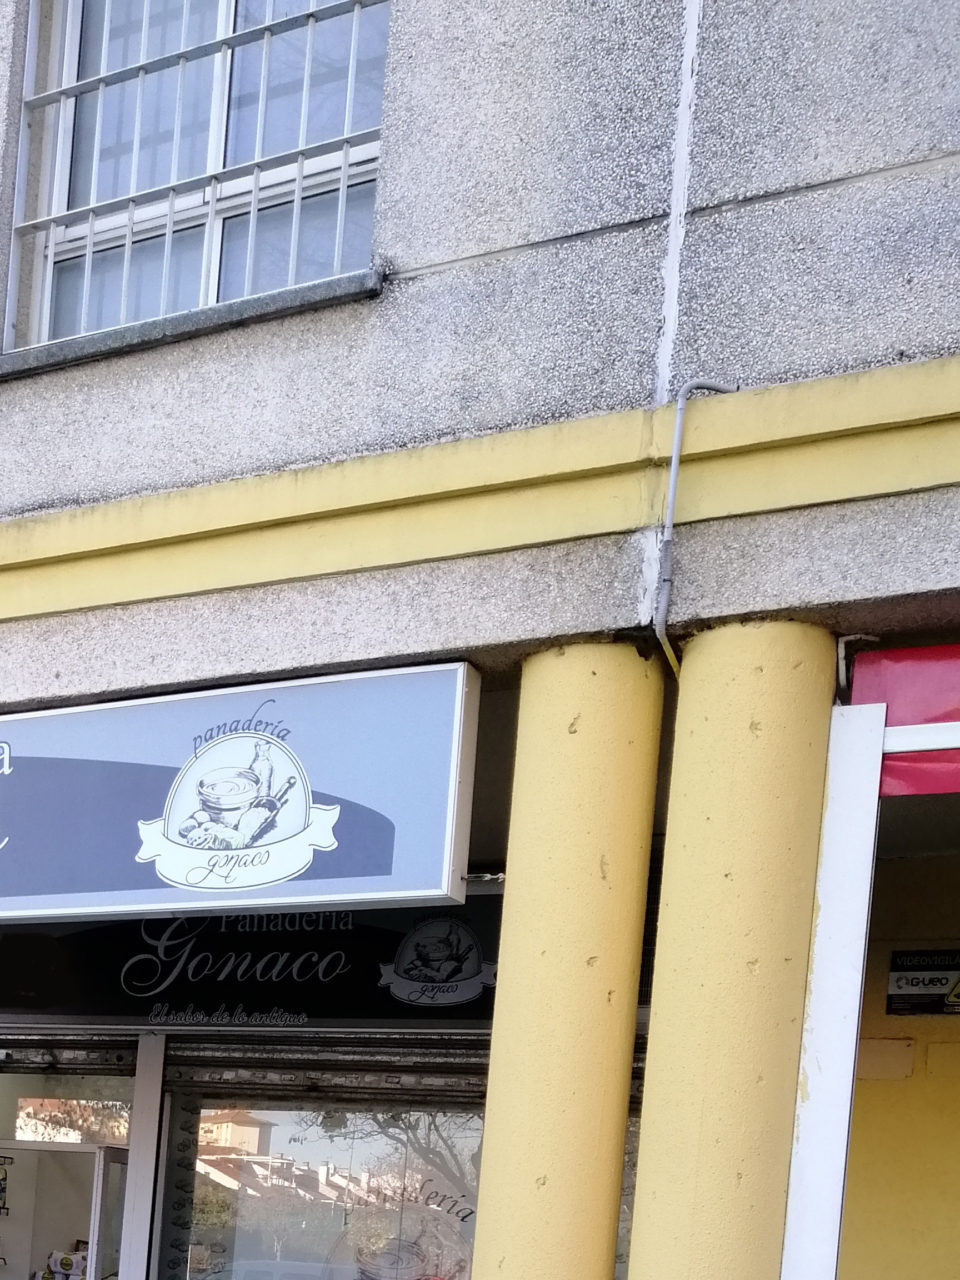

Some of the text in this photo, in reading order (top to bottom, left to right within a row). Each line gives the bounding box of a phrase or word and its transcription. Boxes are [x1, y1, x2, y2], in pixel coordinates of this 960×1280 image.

[192, 699, 292, 760] panadería
[185, 850, 270, 885] gonaco
[120, 914, 351, 998] Gonaco
[407, 982, 459, 1000] gonaco
[148, 1003, 168, 1025] El
[167, 1003, 208, 1024] sabor
[209, 1003, 231, 1024] de
[248, 1005, 308, 1026] antiguo
